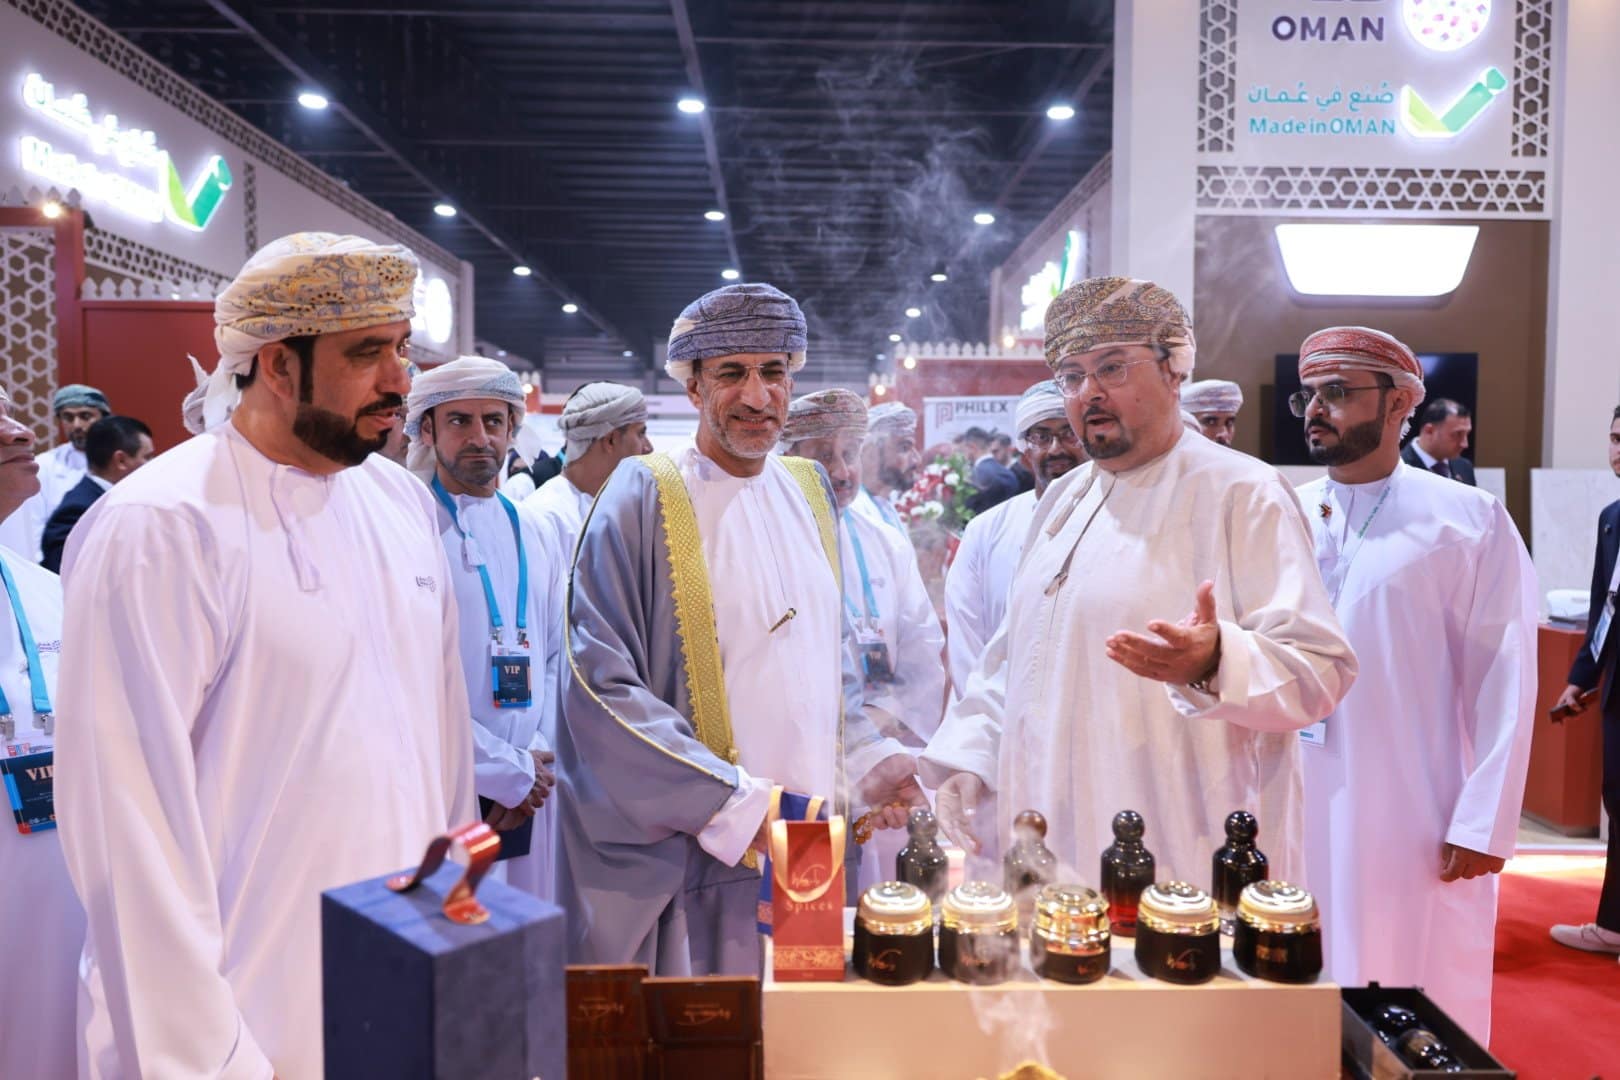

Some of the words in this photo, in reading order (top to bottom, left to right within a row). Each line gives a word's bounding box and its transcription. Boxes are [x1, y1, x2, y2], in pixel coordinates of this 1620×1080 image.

[1272, 16, 1384, 41] OMAN
[1316, 86, 1342, 111] في
[956, 400, 1009, 414] PHILEX
[504, 665, 520, 675] VIP
